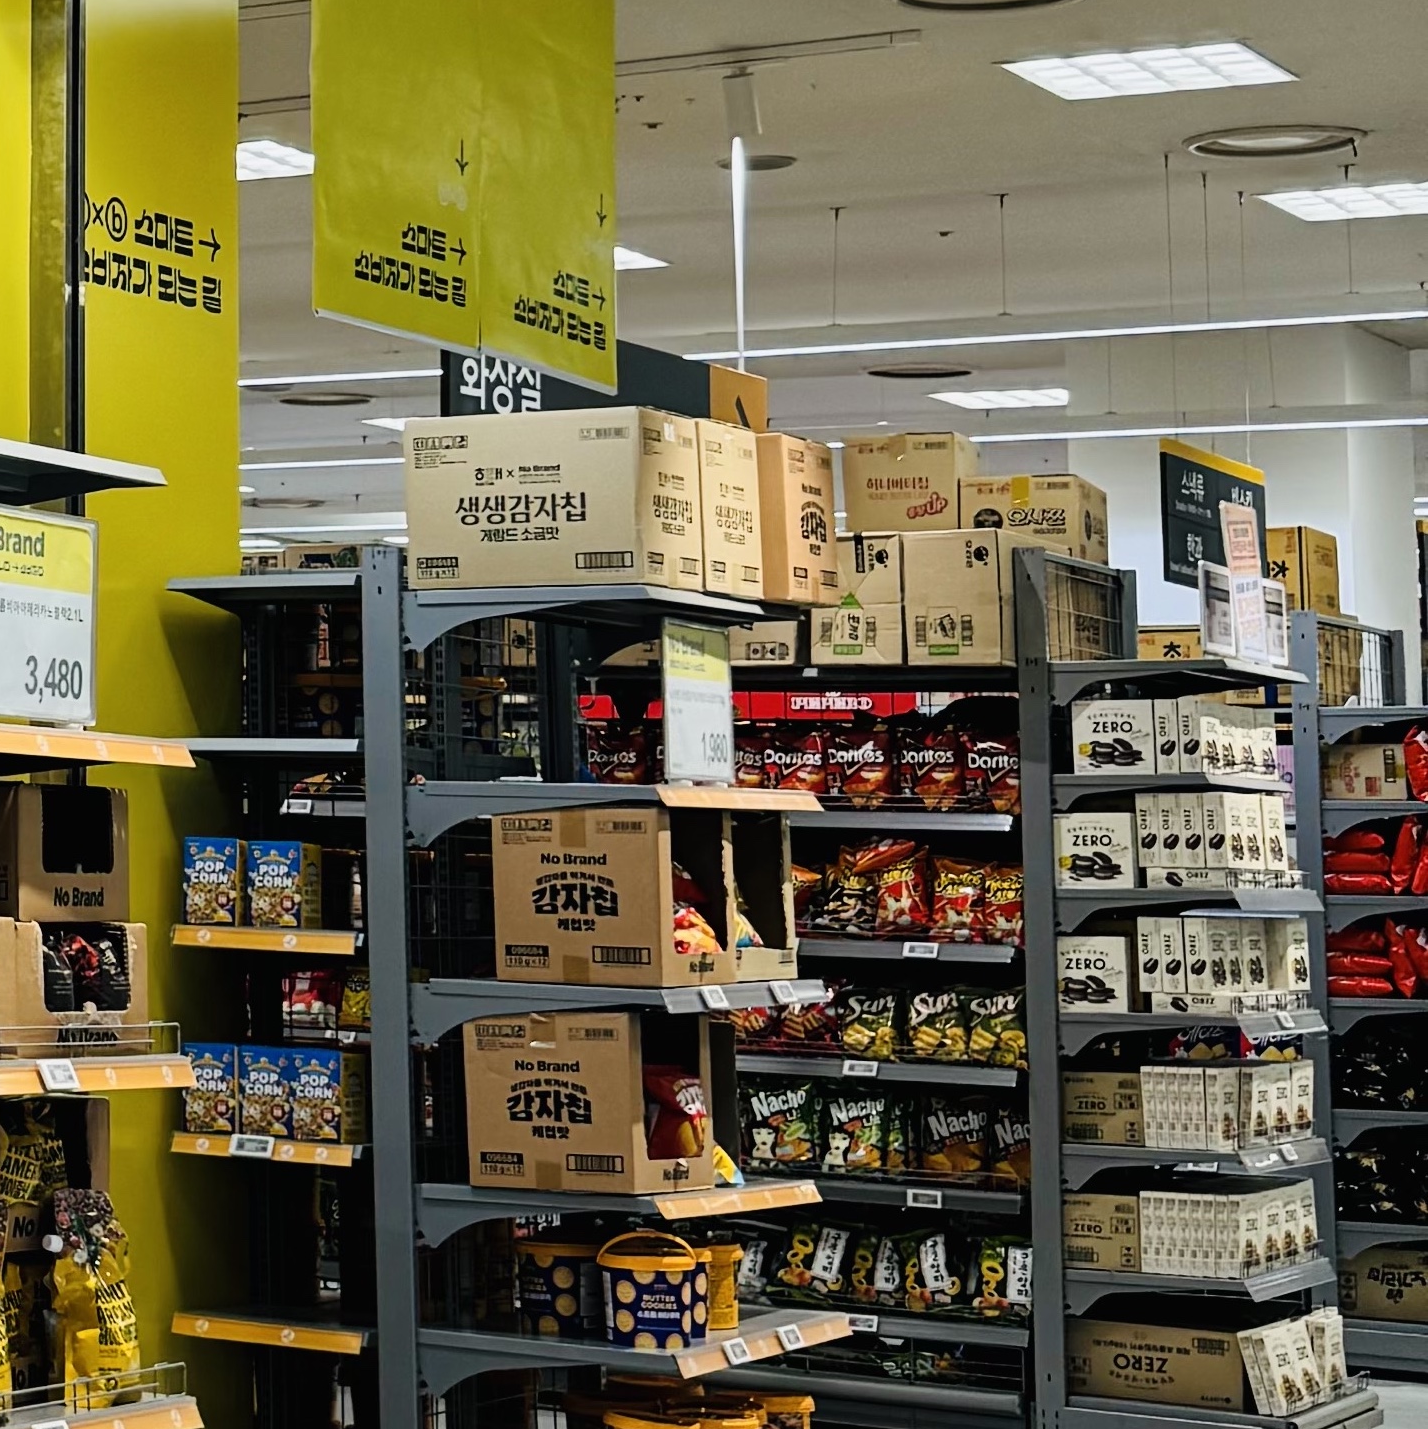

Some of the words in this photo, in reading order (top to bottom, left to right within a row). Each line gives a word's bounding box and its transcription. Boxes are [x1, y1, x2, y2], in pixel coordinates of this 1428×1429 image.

[158, 266, 198, 308] 되는
[202, 278, 222, 315] 길
[355, 249, 414, 294] 소비자가
[419, 267, 448, 302] 되는
[452, 276, 466, 307] 길
[455, 492, 587, 526] 생생감자칩
[521, 526, 560, 543] 소금맛
[25, 655, 83, 703] 3,480
[1092, 721, 1133, 733] ZERO
[1073, 835, 1112, 847] ZERO
[190, 872, 226, 884] CORN
[194, 861, 225, 873] POP
[259, 864, 288, 876] POP
[532, 881, 619, 917] 감자칩
[1065, 958, 1106, 970] ZERO
[847, 994, 895, 1021] Sun
[912, 992, 958, 1023] Sun
[970, 994, 1022, 1025] Sun
[194, 1068, 224, 1081] POP
[507, 1088, 592, 1124] 감자칩
[751, 1089, 806, 1121] Nacho
[830, 1098, 885, 1125] Nacho
[1077, 1101, 1106, 1111] ZERO
[928, 1111, 987, 1142] Nacho
[13, 1215, 36, 1238] No
[1073, 1224, 1102, 1234] ZERO
